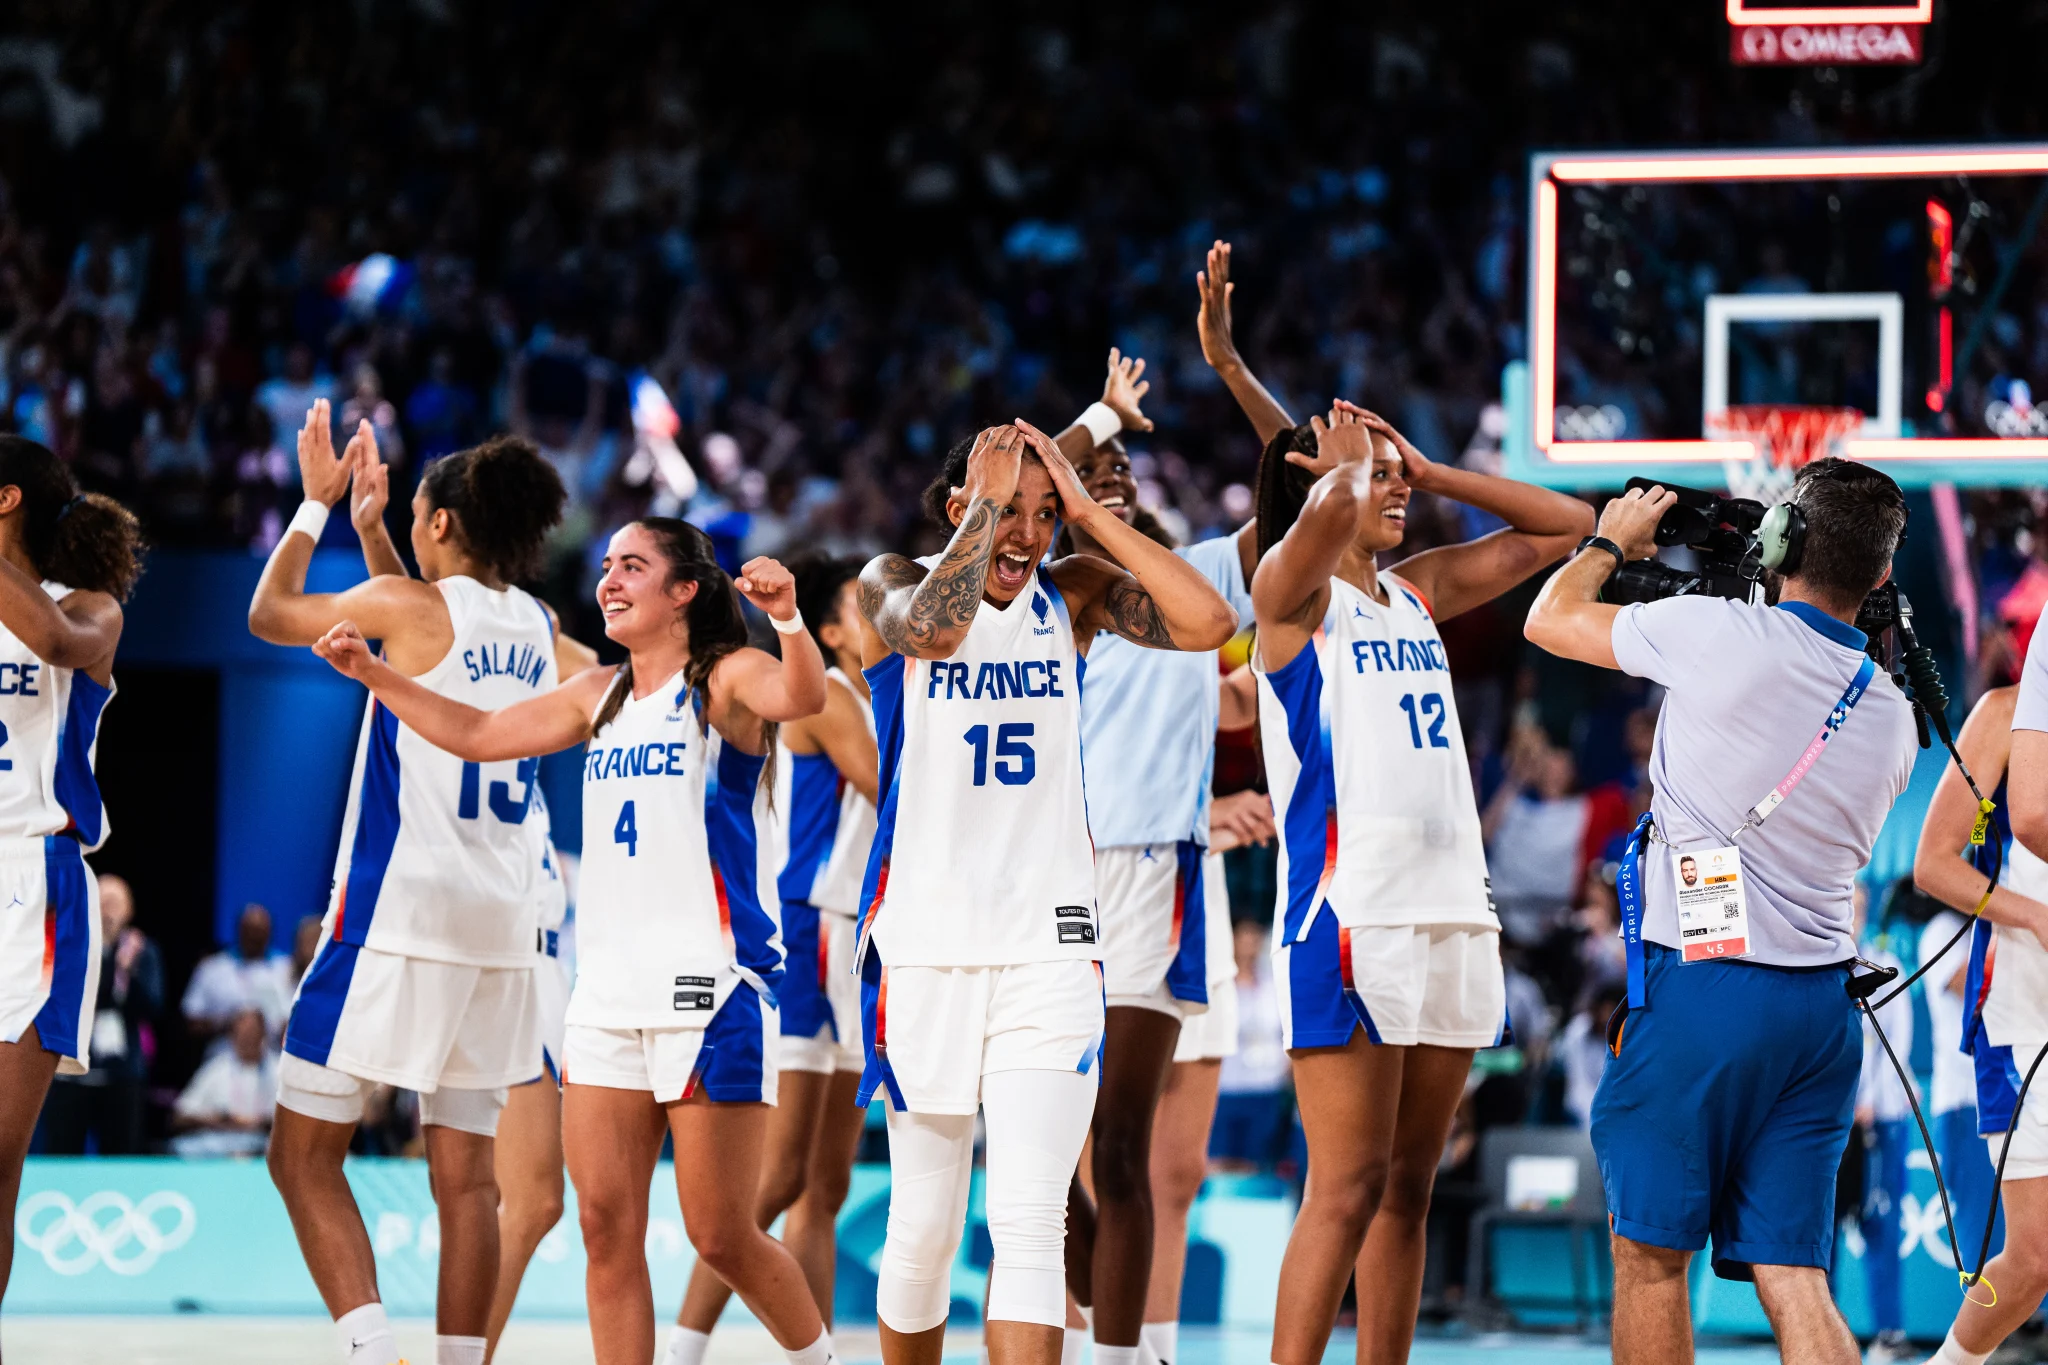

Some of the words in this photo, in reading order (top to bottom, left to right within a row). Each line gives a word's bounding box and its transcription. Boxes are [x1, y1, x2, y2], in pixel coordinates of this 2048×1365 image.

[1781, 25, 1915, 61] OMEGA
[1033, 625, 1055, 636] FRANCE
[463, 642, 547, 688] SALAÜN
[1352, 638, 1449, 673] FRANC
[928, 660, 1064, 700] FRANCE
[1399, 693, 1450, 749] 12
[963, 722, 1036, 786] 15
[1781, 767, 1804, 792] PARIS
[1802, 742, 1822, 767] 2024
[614, 800, 637, 857] 4
[1622, 864, 1633, 900] 2024
[1084, 928, 1092, 937] 42
[1626, 904, 1637, 943] PARIS
[698, 996, 711, 1005] 42
